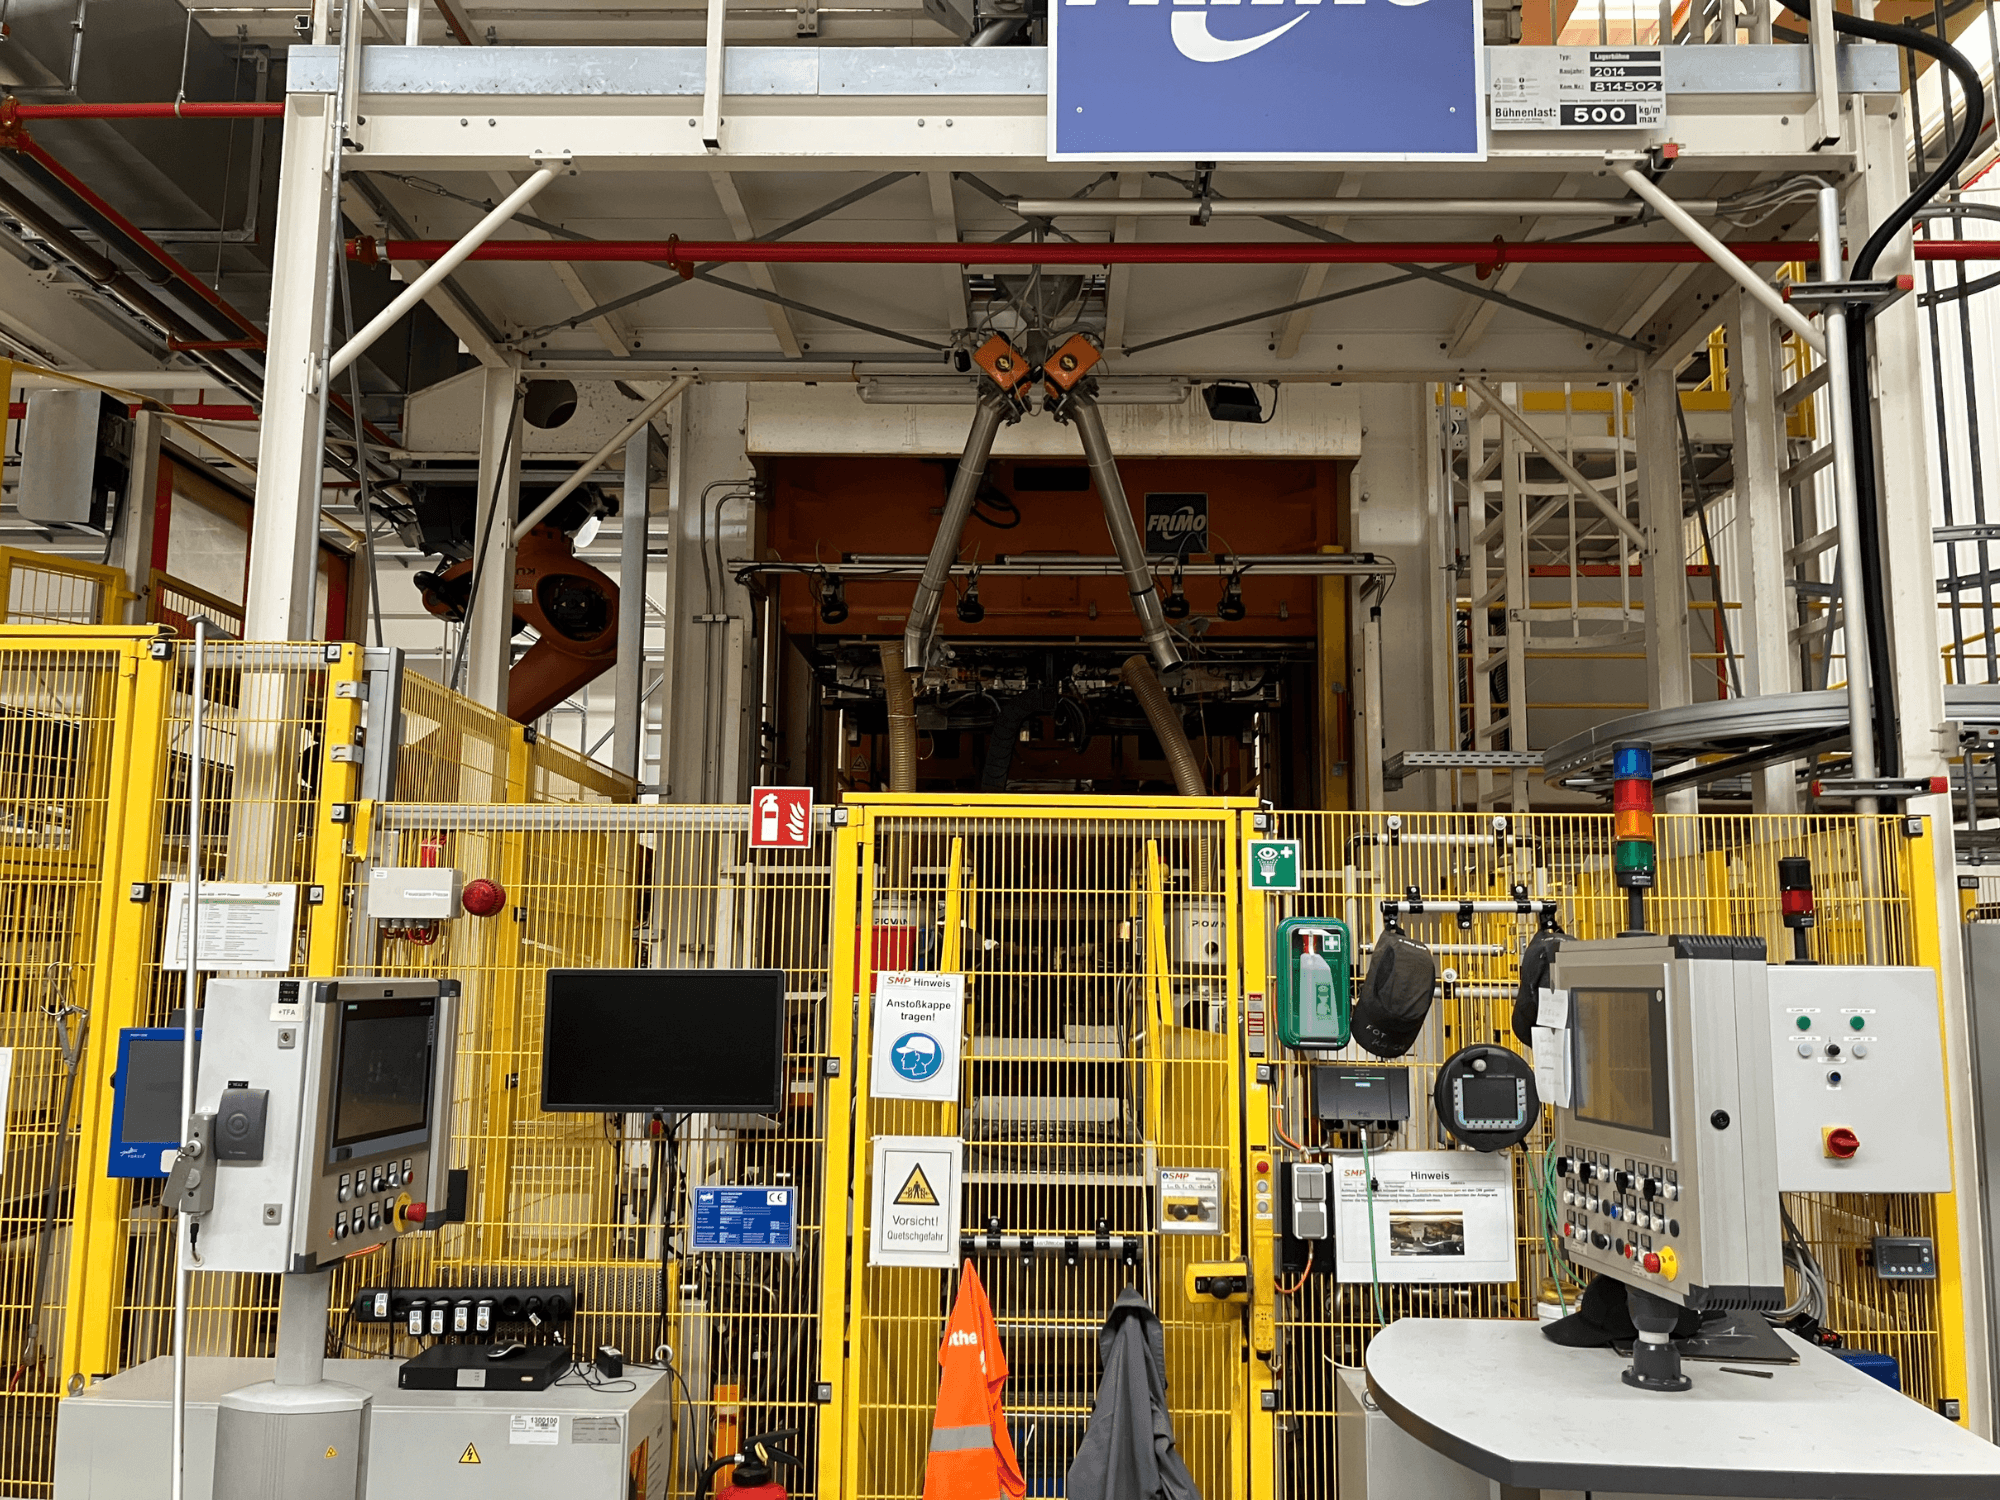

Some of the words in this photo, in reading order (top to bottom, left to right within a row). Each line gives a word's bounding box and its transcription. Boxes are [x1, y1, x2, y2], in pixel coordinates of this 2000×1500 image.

[1594, 53, 1630, 61] Lagerbühne
[1559, 68, 1585, 76] Baujahr:
[1594, 67, 1626, 77] 2014
[1594, 82, 1658, 92] 814502
[1495, 107, 1557, 118] Bühnenlast:
[1573, 107, 1626, 123] 500
[1147, 514, 1207, 532] FRIMO
[886, 976, 912, 984] SMP
[913, 977, 951, 988] Hinweis
[886, 999, 951, 1011] Anstoßkappe
[900, 1012, 936, 1023] tragen!
[1169, 1172, 1190, 1180] SMP
[1343, 1169, 1366, 1177] SMP
[1410, 1171, 1450, 1180] Hinweis
[892, 1214, 939, 1227] Vorsicht!
[887, 1230, 944, 1243] Quetschgefahr
